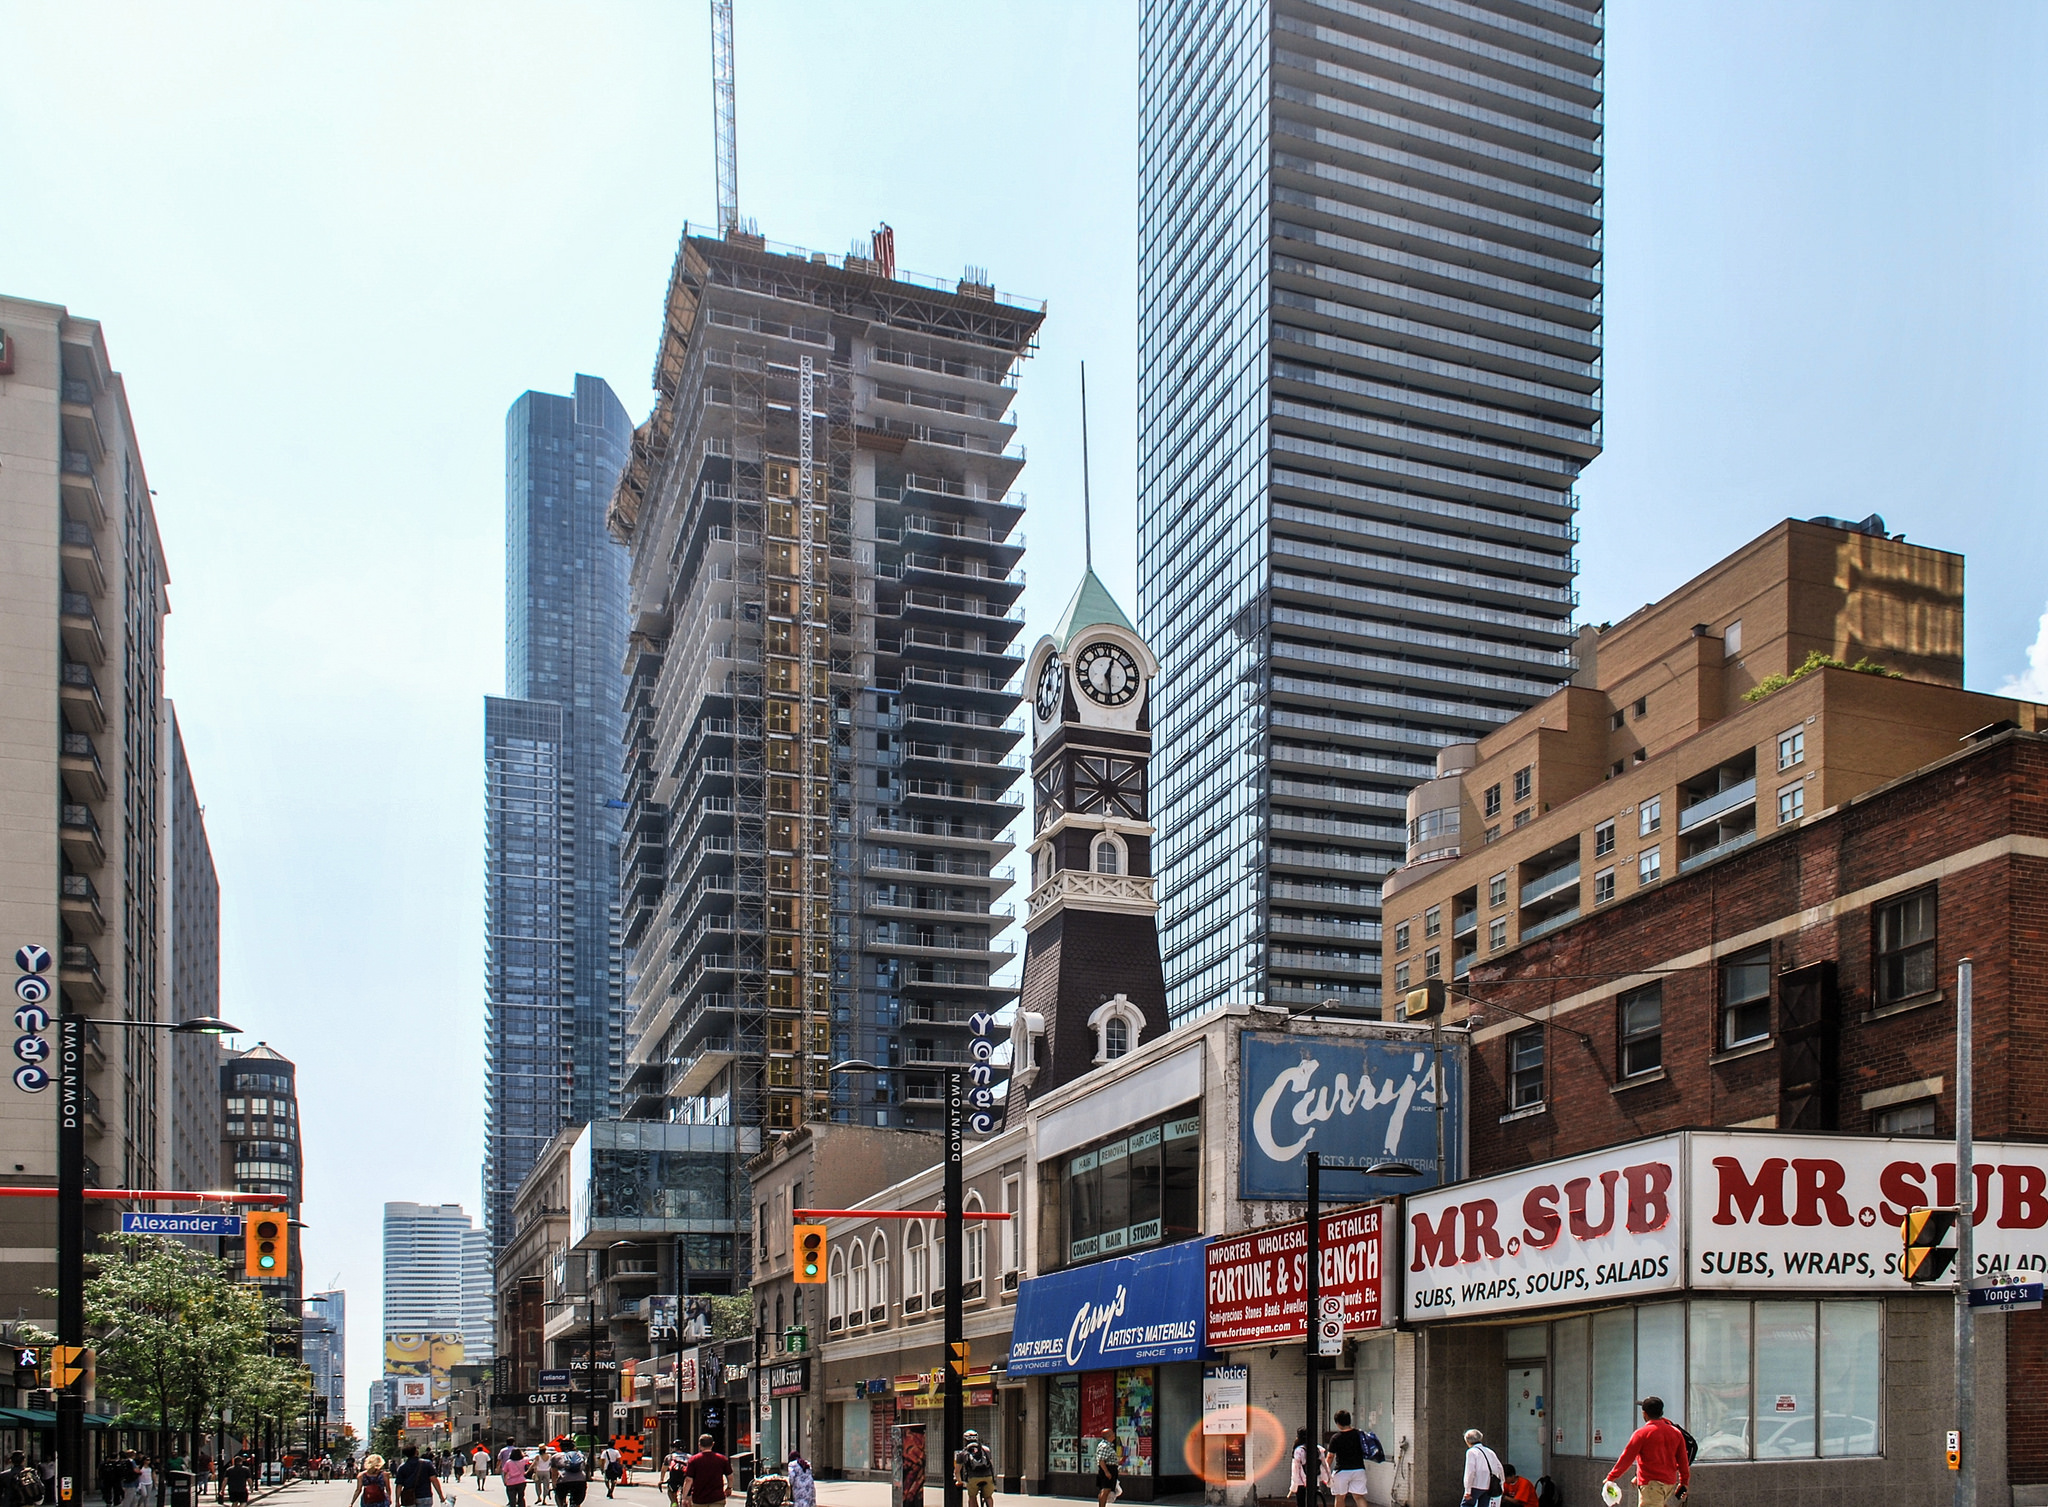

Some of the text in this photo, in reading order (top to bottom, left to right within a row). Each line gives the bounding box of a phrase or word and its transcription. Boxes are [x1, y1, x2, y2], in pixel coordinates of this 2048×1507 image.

[64, 1022, 77, 1128] DOWNTOWN
[1253, 1053, 1448, 1161] Curry's
[951, 1073, 961, 1162] DOWNTOWN
[1175, 1120, 1200, 1135] WIGS
[1131, 1130, 1160, 1149] HAIR CARE
[1101, 1144, 1127, 1160] REMOVAL
[1301, 1155, 1345, 1167] AIST'S
[1078, 1158, 1091, 1169] HAIR
[130, 1216, 233, 1231] Alexander St
[1132, 1222, 1158, 1242] STUDIO
[1073, 1232, 1122, 1257] COLOURS HAIR
[1209, 1213, 1379, 1265] IMPORTER WHOLESAL RETAILER
[1700, 1251, 1775, 1279] SUBS,
[1783, 1251, 1876, 1278] WRAPS,
[1976, 1253, 2048, 1275] SALAD
[1209, 1260, 1272, 1305] FORTUNE
[1276, 1256, 1290, 1296] &
[1414, 1255, 1670, 1309] SUBS, WRAPS, SOUPS, SALADS
[1984, 1288, 2028, 1302] Yonge St
[1209, 1308, 1243, 1326] Semi-precious
[1245, 1305, 1262, 1320] Stones
[1264, 1302, 1281, 1318] Beads
[1365, 1287, 1378, 1304] Etc.
[1066, 1284, 1127, 1366] Curry's
[1107, 1320, 1196, 1348] ARTIST'S MATERIALS
[1209, 1322, 1291, 1340] www.fortunegem.com
[1012, 1337, 1064, 1358] CRAFT SUPPLIES
[1135, 1346, 1193, 1358] SINCE 1911
[1011, 1362, 1023, 1370] 490
[1024, 1361, 1050, 1370] YONGE
[1215, 1365, 1247, 1379] Notice
[771, 1368, 802, 1387] HAIR STORY
[528, 1394, 557, 1404] GATE
[560, 1393, 567, 1403] 2
[614, 1408, 627, 1416] 40
